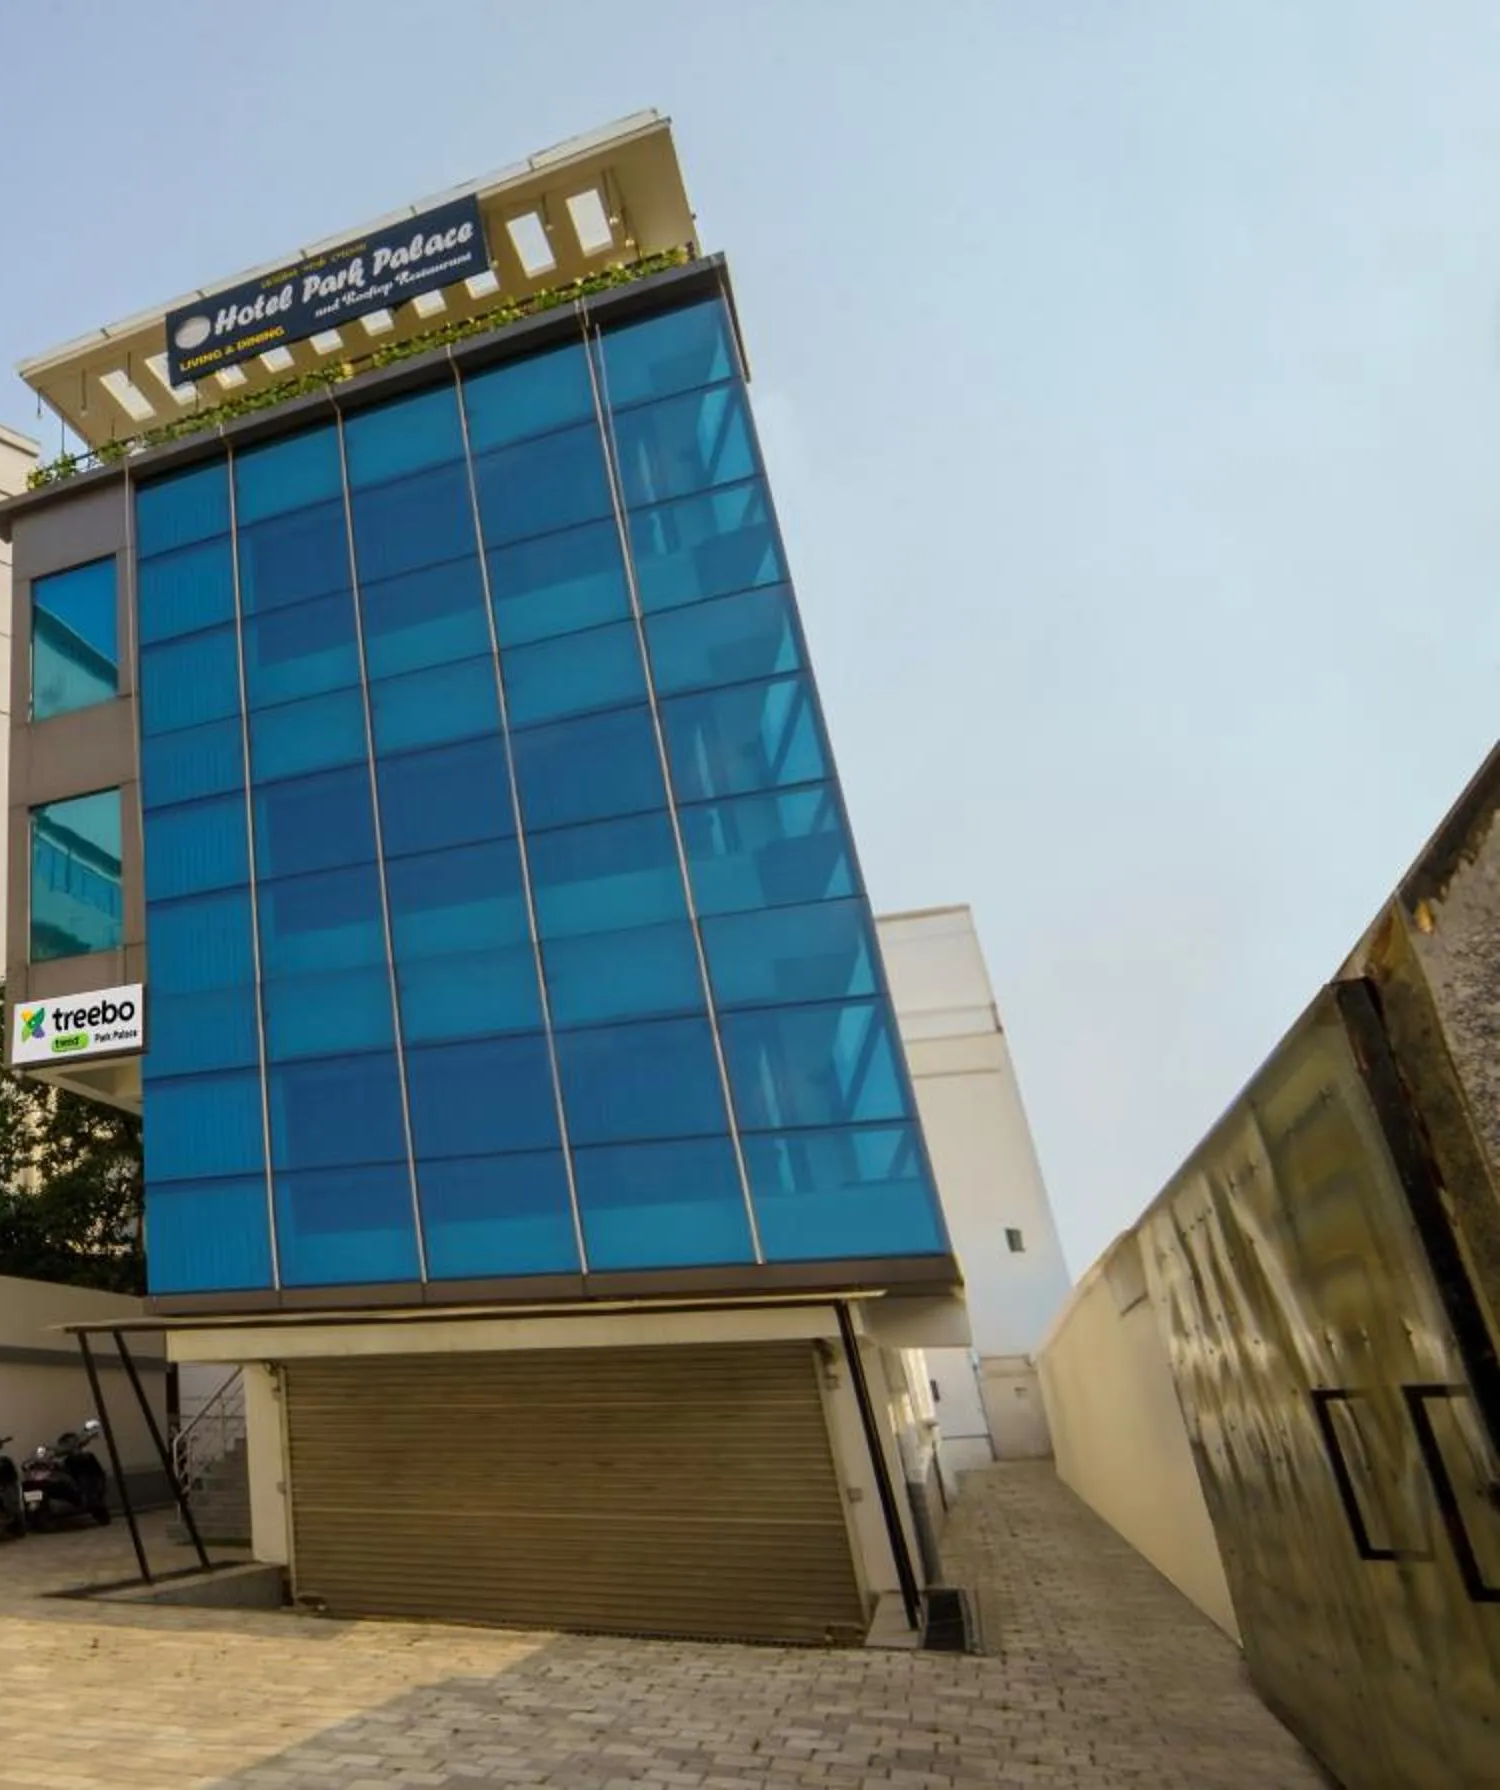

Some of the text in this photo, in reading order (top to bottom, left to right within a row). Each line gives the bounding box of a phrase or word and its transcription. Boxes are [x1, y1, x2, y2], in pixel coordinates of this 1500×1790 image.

[214, 285, 293, 336] Hotel
[303, 257, 366, 303] Park
[372, 221, 474, 276] Palace
[180, 349, 222, 372] LIVING
[237, 325, 286, 350] DINING
[52, 999, 136, 1032] treebo
[94, 1029, 138, 1044] Park Palace
